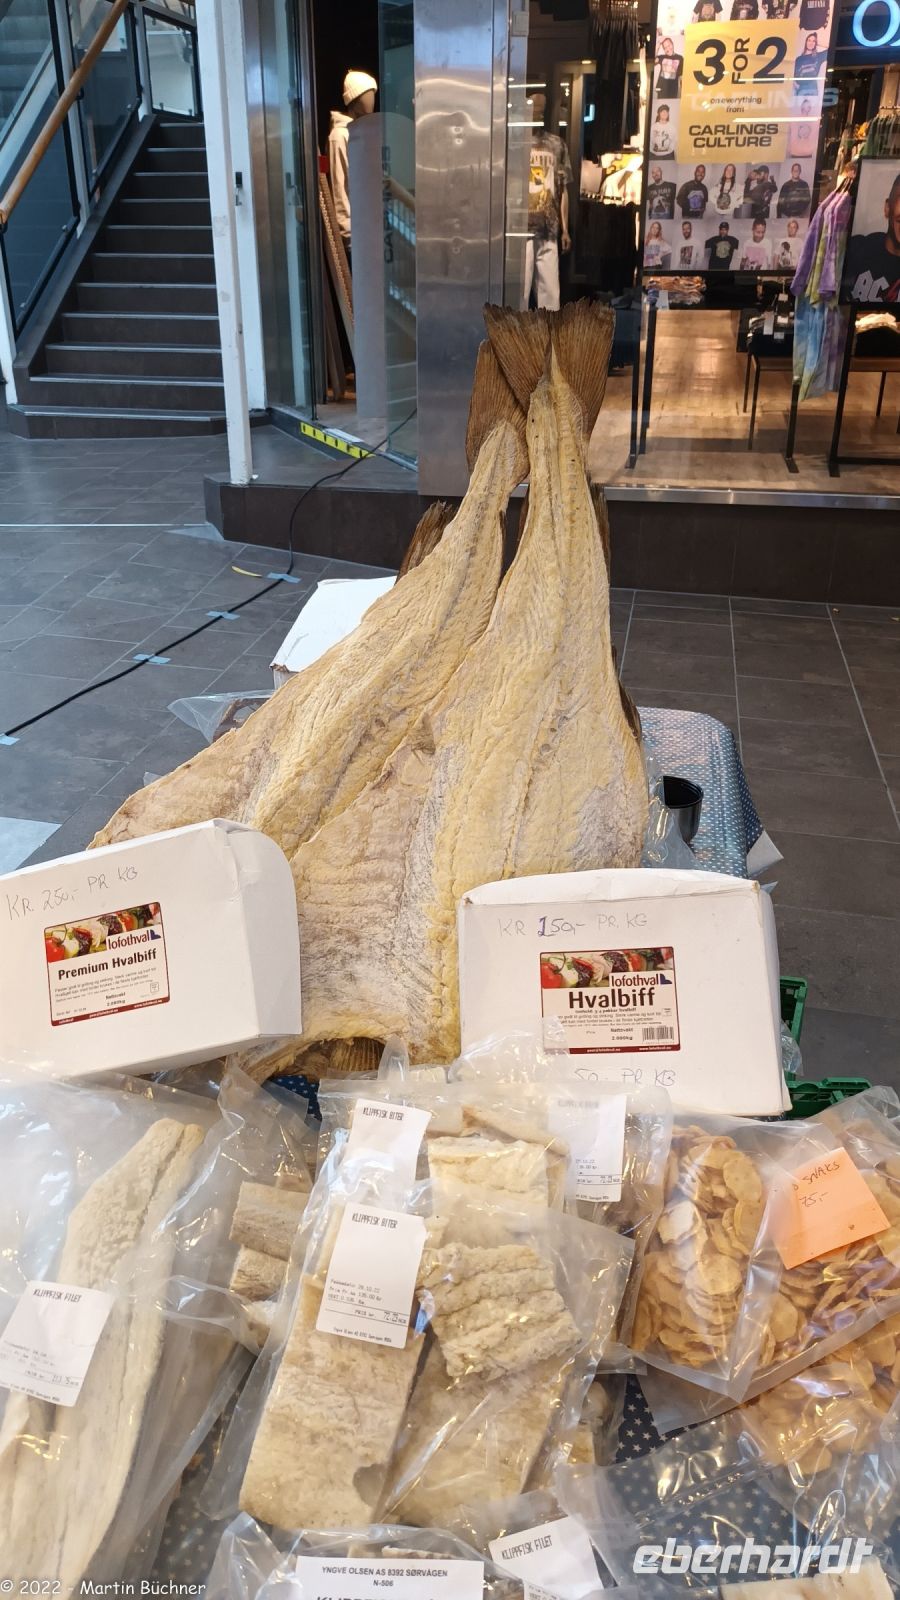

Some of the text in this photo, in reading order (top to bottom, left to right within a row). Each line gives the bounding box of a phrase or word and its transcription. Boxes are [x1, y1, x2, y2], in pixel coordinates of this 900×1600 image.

[693, 36, 788, 86] 3 FOR 2
[688, 124, 779, 136] CARLINGS
[87, 874, 109, 894] PR
[498, 918, 527, 937] KR
[626, 912, 648, 928] KG
[108, 929, 150, 950] lofothval
[58, 961, 109, 981] Premium
[112, 947, 157, 969] Hvalbiff
[611, 973, 659, 987] lofothval
[569, 987, 656, 1009] Hvalbiff
[362, 1107, 404, 1121] KLIPPFISK BITER
[352, 1212, 398, 1229] KLIPPFISK BITER
[33, 1288, 82, 1303] KLIPPFISK FILET
[501, 1535, 553, 1561] KLIPPFISK FILET
[321, 1566, 347, 1574] YNGVE
[348, 1567, 374, 1576] OLSEN
[375, 1568, 386, 1576] AS
[405, 1567, 448, 1577] SØRVÅGEN
